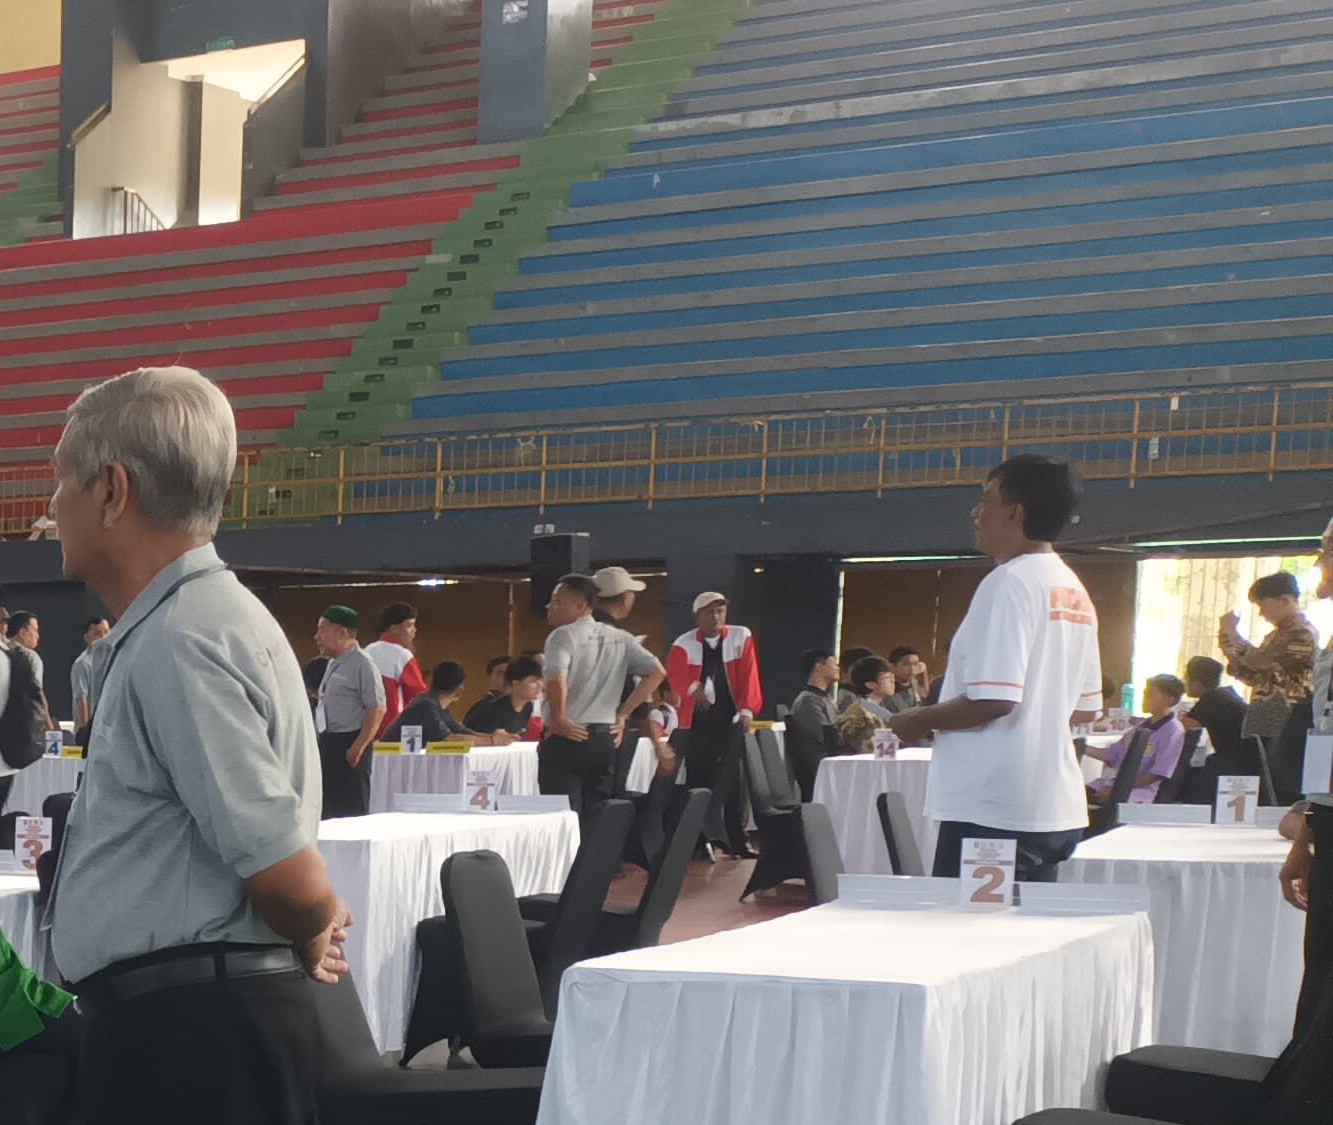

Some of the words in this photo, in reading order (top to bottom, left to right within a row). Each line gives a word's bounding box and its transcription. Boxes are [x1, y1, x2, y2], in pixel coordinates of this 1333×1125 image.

[47, 740, 59, 756] 4
[406, 738, 416, 752] 1
[876, 742, 896, 758] 14
[469, 785, 490, 811] 4
[1226, 794, 1246, 822] 1
[21, 839, 44, 870] 3
[969, 865, 1006, 904] 2
